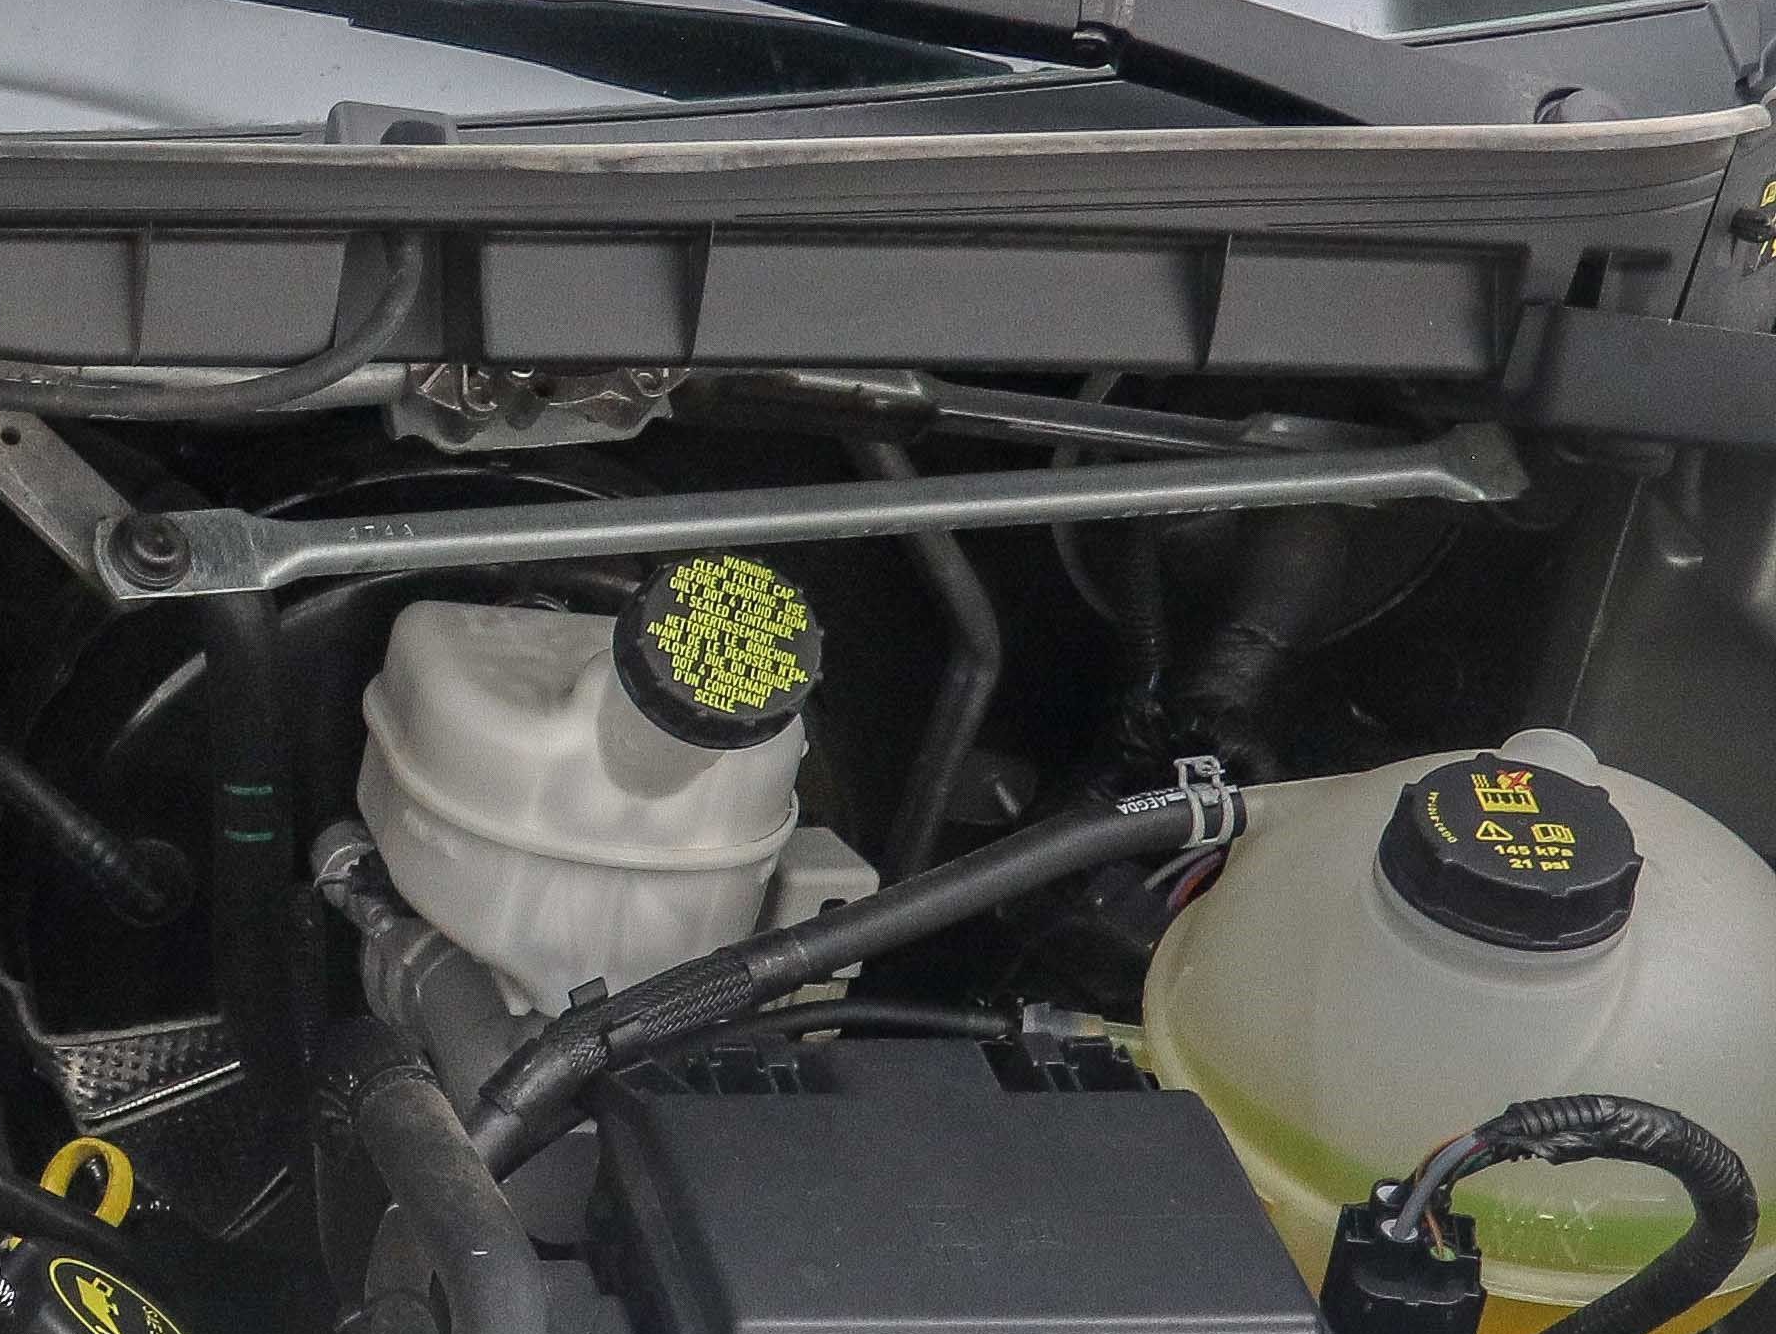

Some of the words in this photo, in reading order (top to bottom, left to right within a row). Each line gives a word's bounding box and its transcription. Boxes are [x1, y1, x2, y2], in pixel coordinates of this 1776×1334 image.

[677, 566, 718, 589] BEFORE
[784, 600, 806, 616] USE
[693, 559, 727, 579] CLEAN
[732, 570, 770, 593] FILLER
[772, 583, 794, 599] CAP
[670, 578, 697, 596] ONLY
[703, 588, 724, 603] DOT
[728, 597, 736, 607] 4
[741, 599, 771, 622] FLUID
[777, 611, 807, 631] FROM
[676, 593, 684, 603] A
[689, 597, 729, 617] SEALED
[646, 621, 683, 644] AVANT
[687, 635, 701, 648] DE
[706, 641, 720, 654] LE
[665, 614, 719, 641] NETTOYER
[725, 633, 739, 647] LE
[746, 637, 796, 665] BOUCHON
[658, 639, 698, 661] PLOYER
[705, 653, 726, 669] QUE
[750, 667, 790, 692] LIQUIDE
[672, 655, 693, 671] DOT
[699, 664, 706, 675] 4
[710, 668, 773, 697] PROVENANT
[673, 669, 700, 687] D'UN
[705, 679, 767, 709] CONTENANT
[1116, 795, 1168, 814] AEGDA
[1494, 845, 1531, 856] 145
[1535, 845, 1574, 857] kPa
[1509, 858, 1533, 869] 21
[1540, 860, 1570, 871] psi
